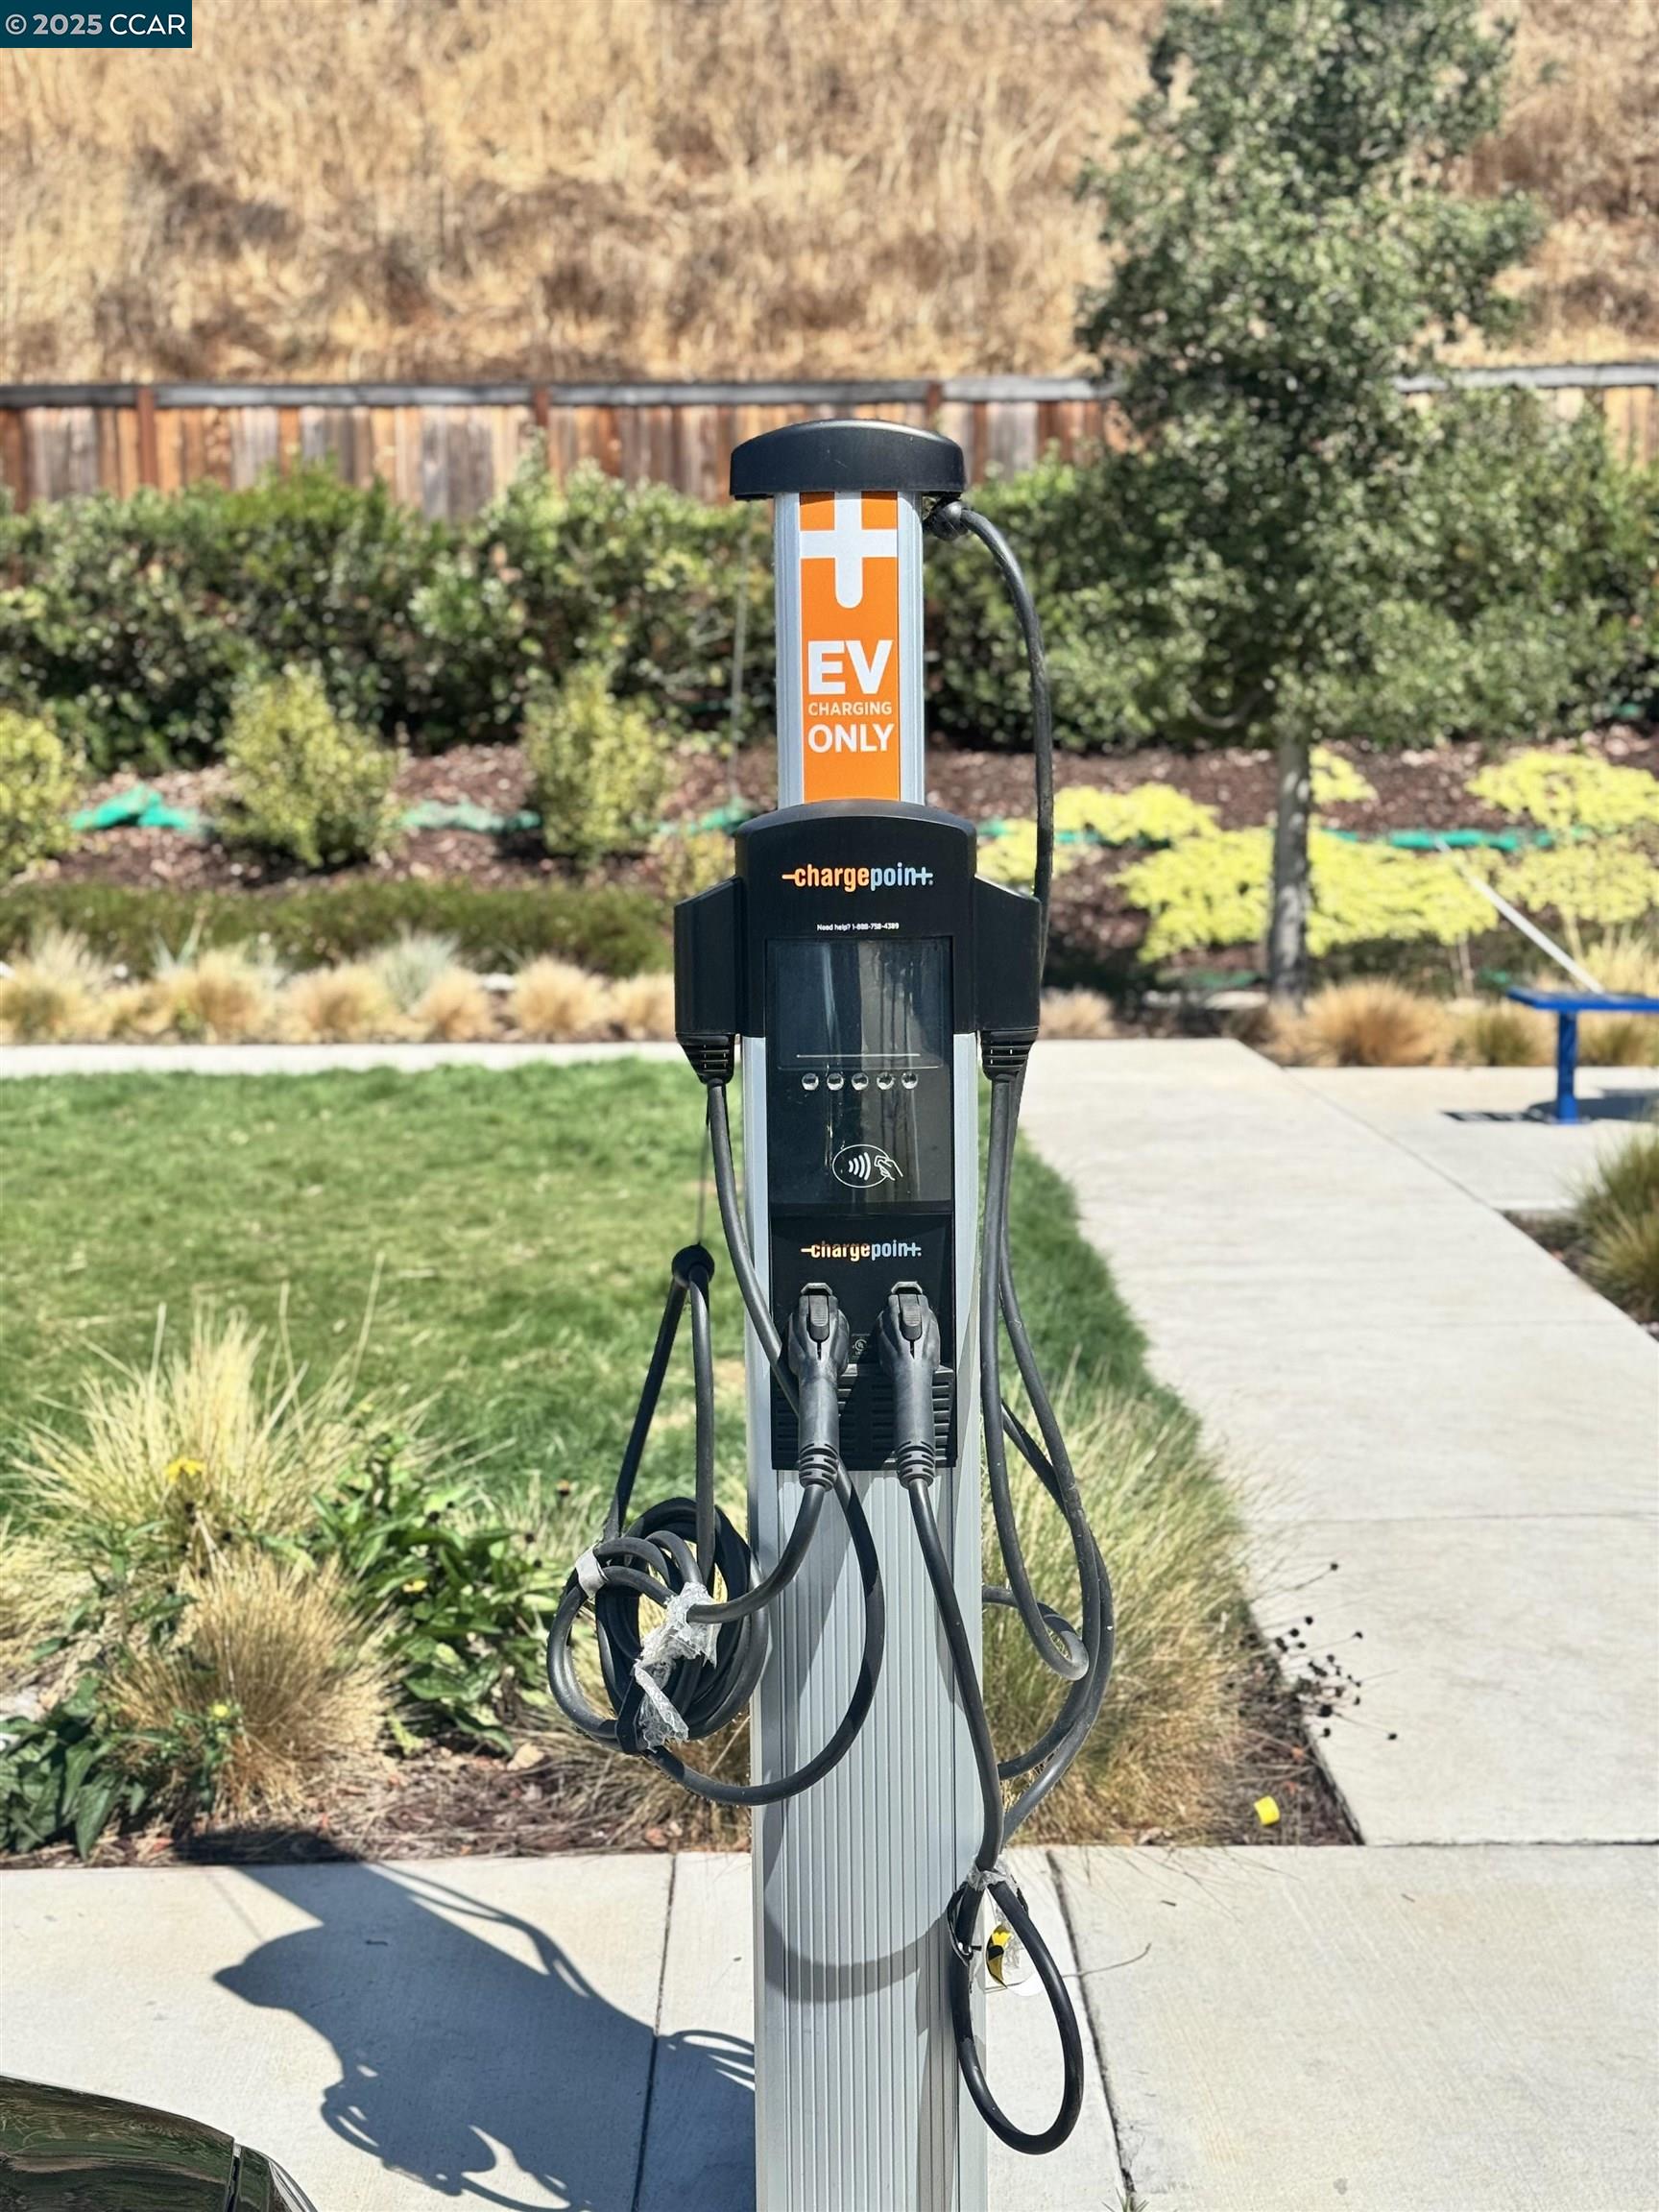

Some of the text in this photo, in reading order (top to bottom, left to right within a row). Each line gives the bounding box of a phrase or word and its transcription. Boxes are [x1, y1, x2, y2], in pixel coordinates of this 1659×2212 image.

[807, 639, 894, 695] EV
[807, 701, 893, 716] CHARGING
[807, 723, 895, 754] ONLY
[834, 923, 851, 932] help?
